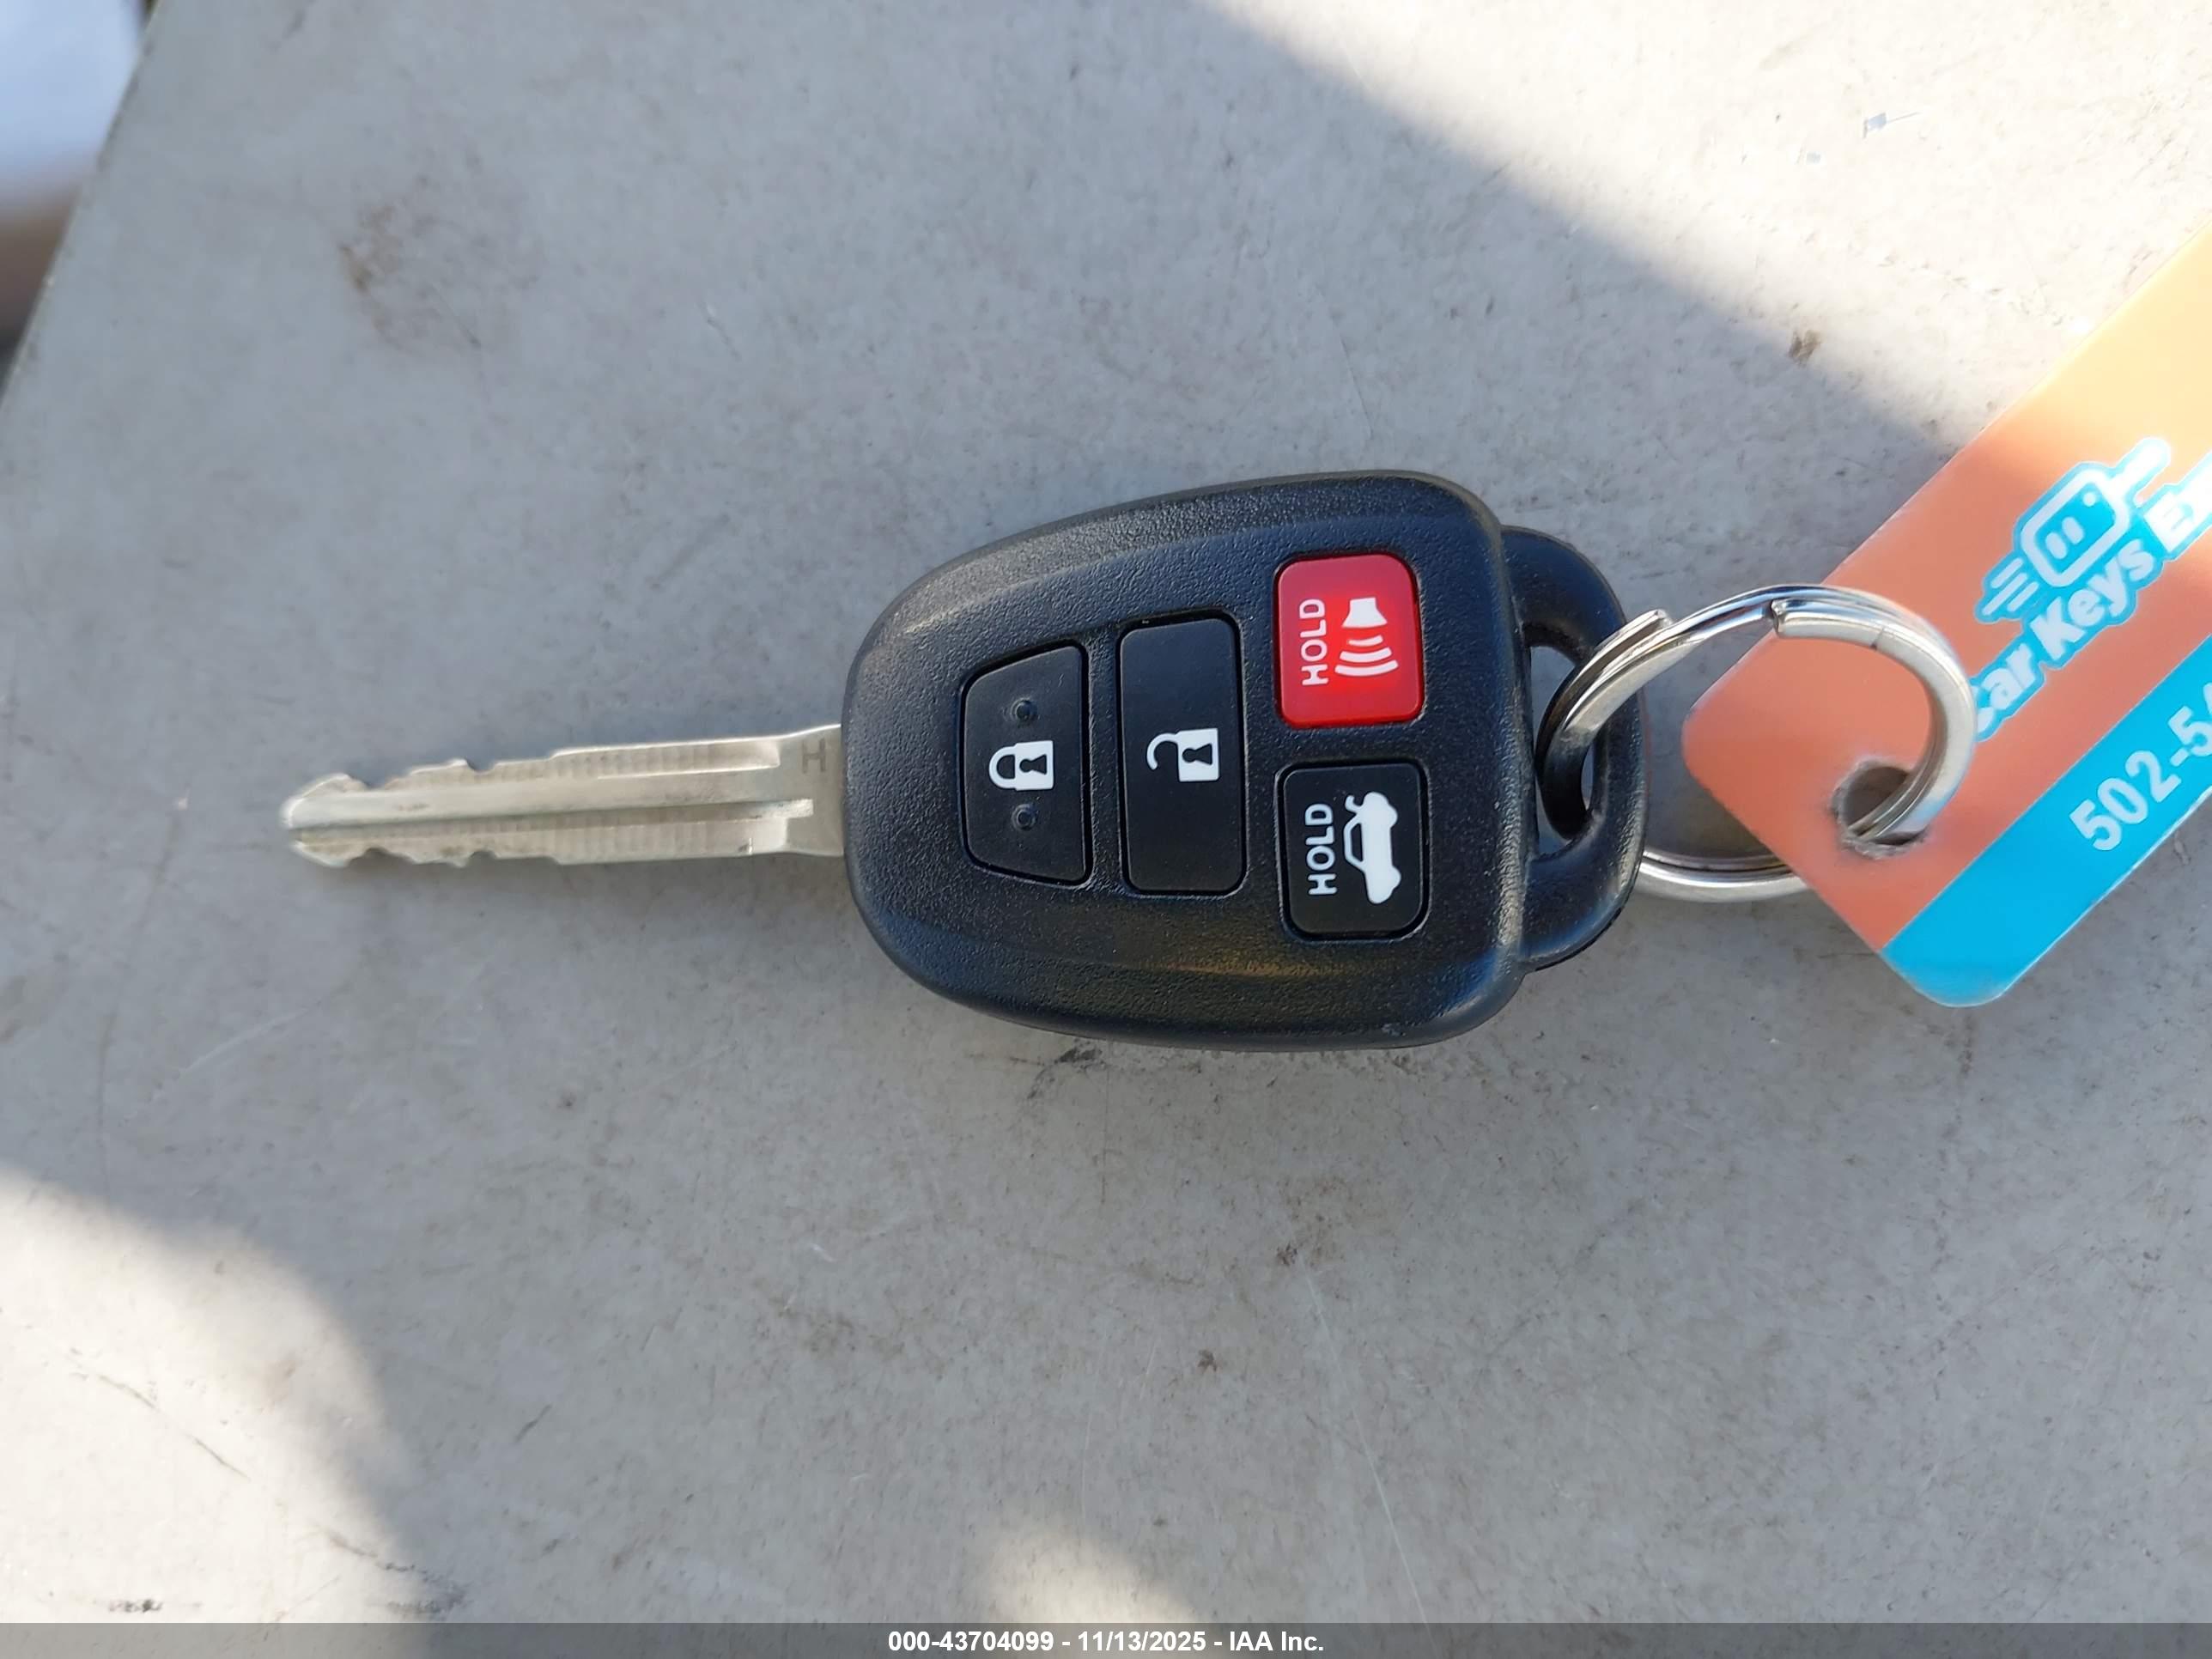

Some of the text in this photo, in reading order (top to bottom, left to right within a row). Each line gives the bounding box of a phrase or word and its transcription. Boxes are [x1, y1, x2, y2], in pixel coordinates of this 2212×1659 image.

[1298, 599, 1328, 686] HOLD
[2030, 538, 2154, 660] Keys
[801, 738, 826, 774] H
[1304, 803, 1337, 896] HOLD
